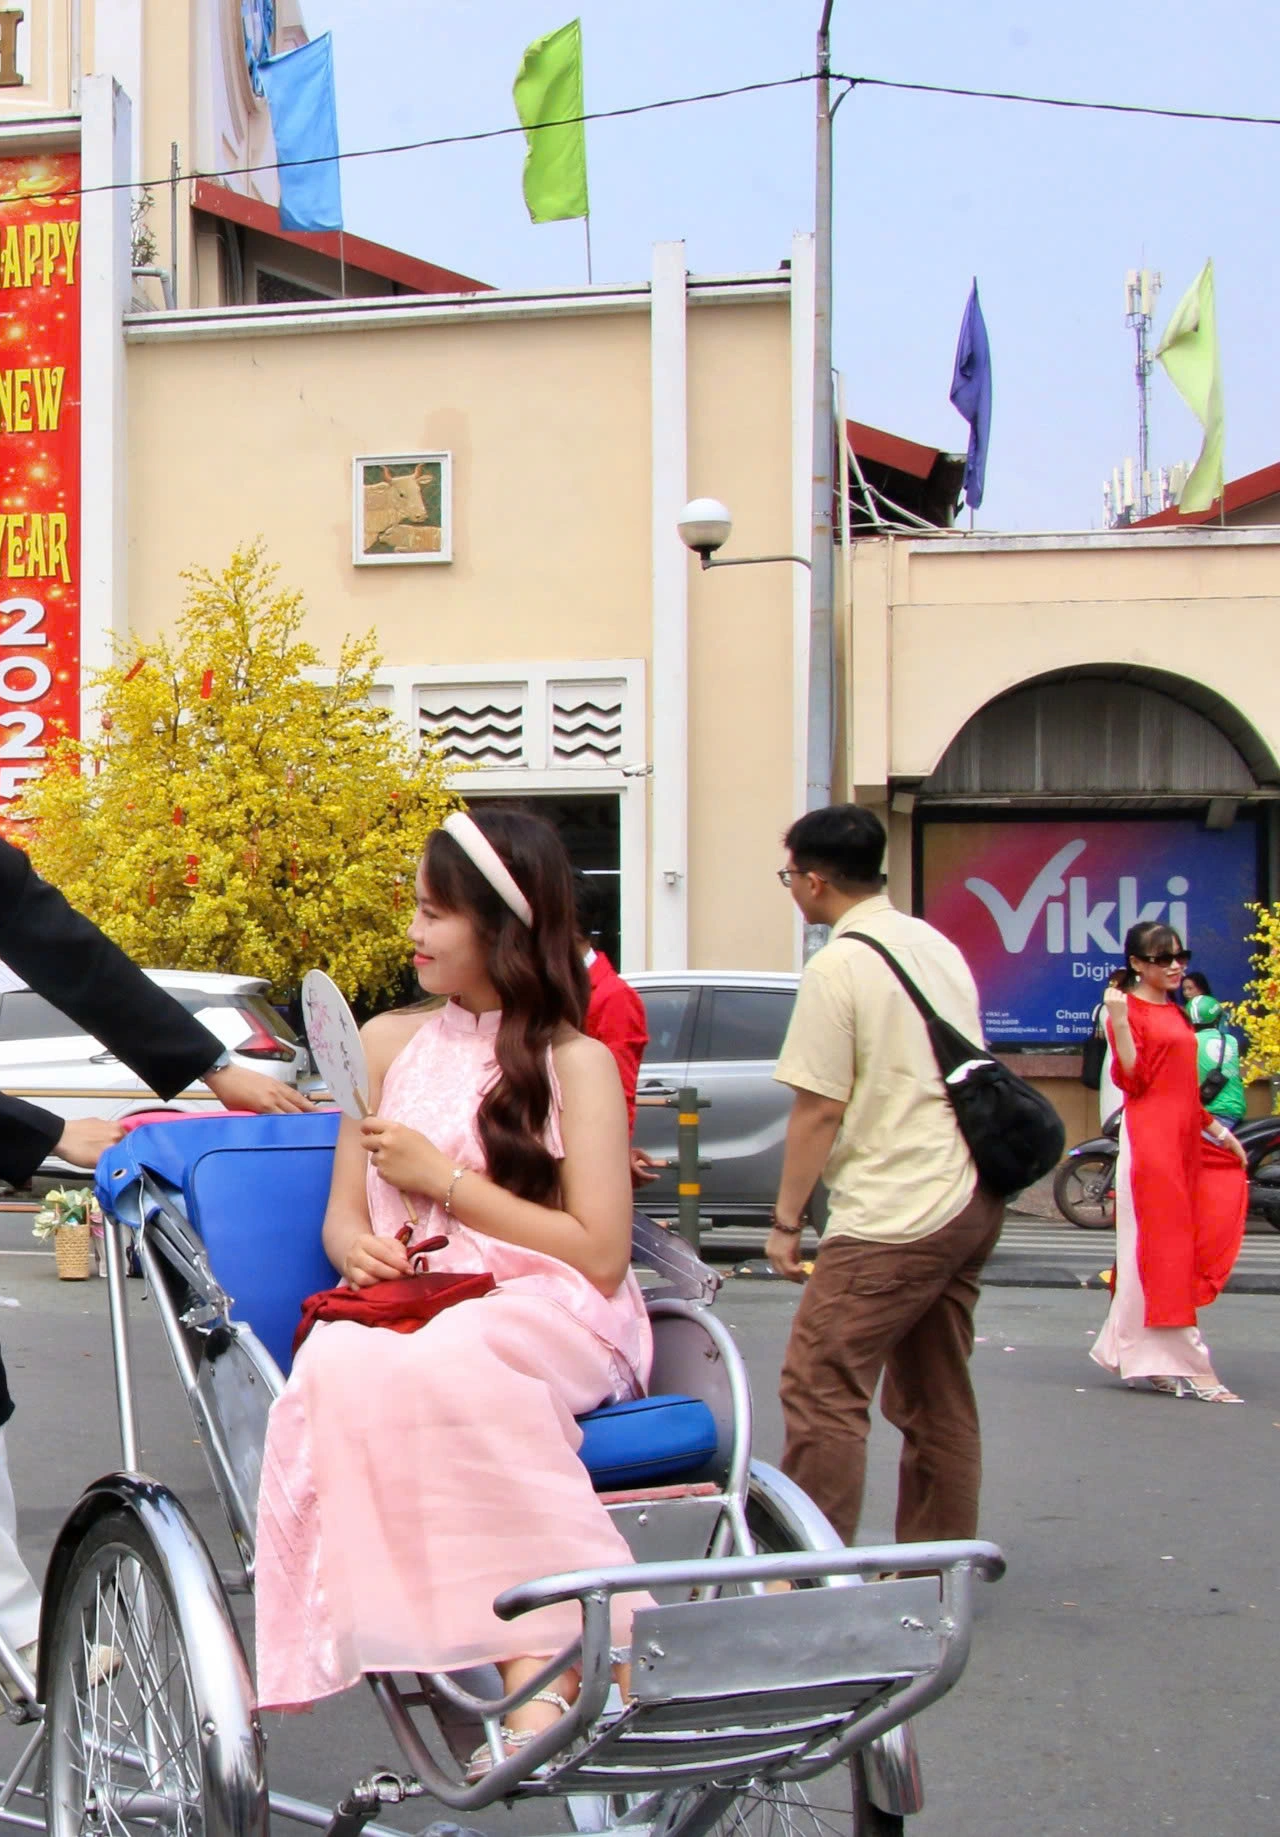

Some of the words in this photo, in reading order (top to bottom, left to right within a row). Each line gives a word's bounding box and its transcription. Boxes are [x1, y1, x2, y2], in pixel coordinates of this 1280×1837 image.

[965, 838, 1190, 954] Vikki
[1072, 962, 1127, 982] Digit
[1056, 1009, 1090, 1022] Chạm
[1056, 1024, 1070, 1034] Be
